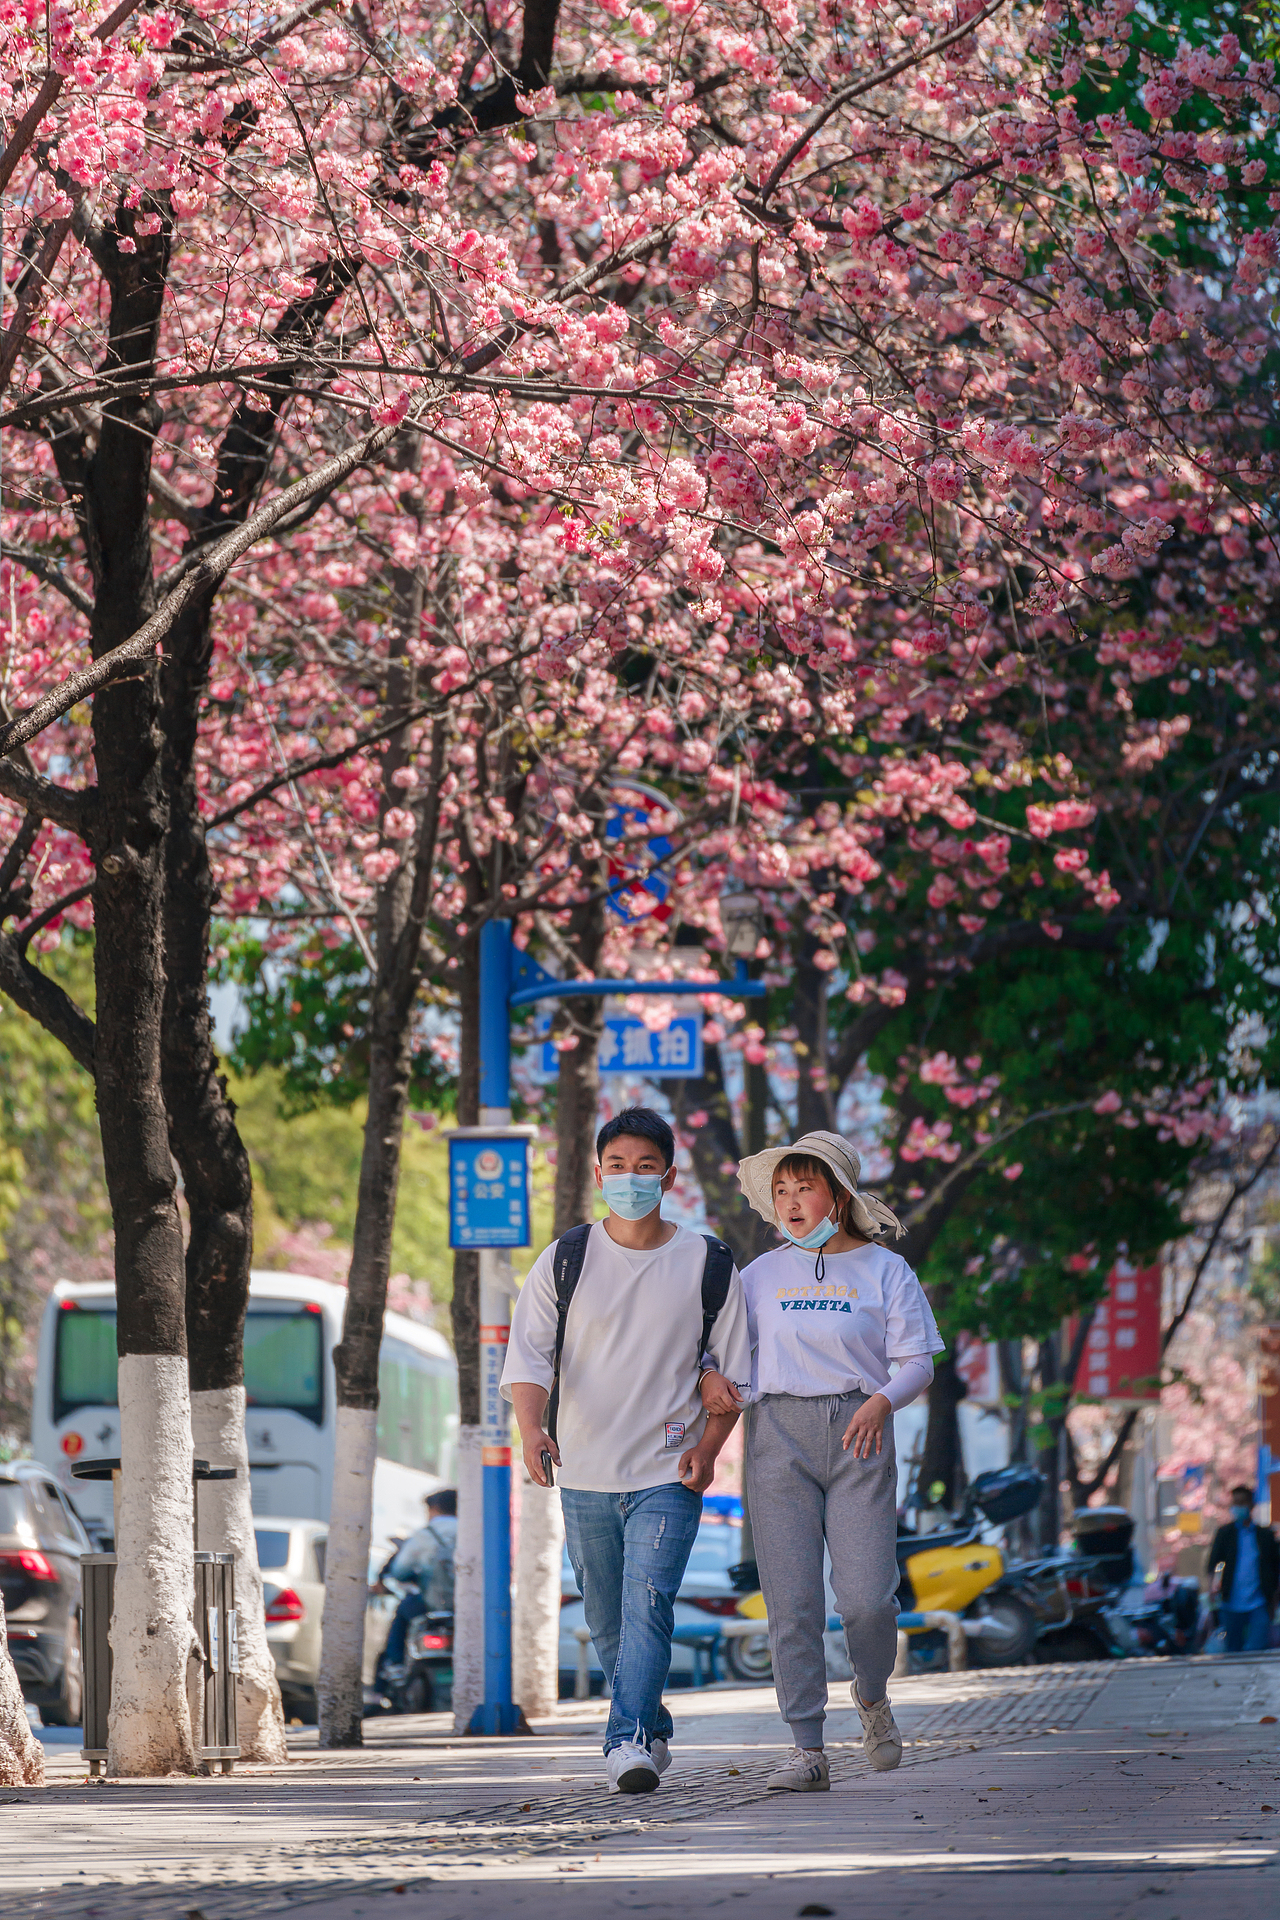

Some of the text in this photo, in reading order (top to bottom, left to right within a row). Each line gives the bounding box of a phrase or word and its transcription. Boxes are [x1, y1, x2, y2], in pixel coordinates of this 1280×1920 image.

[473, 1182, 505, 1200] 公安
[775, 1285, 859, 1299] BOTTEGA
[780, 1300, 852, 1313] VENETA
